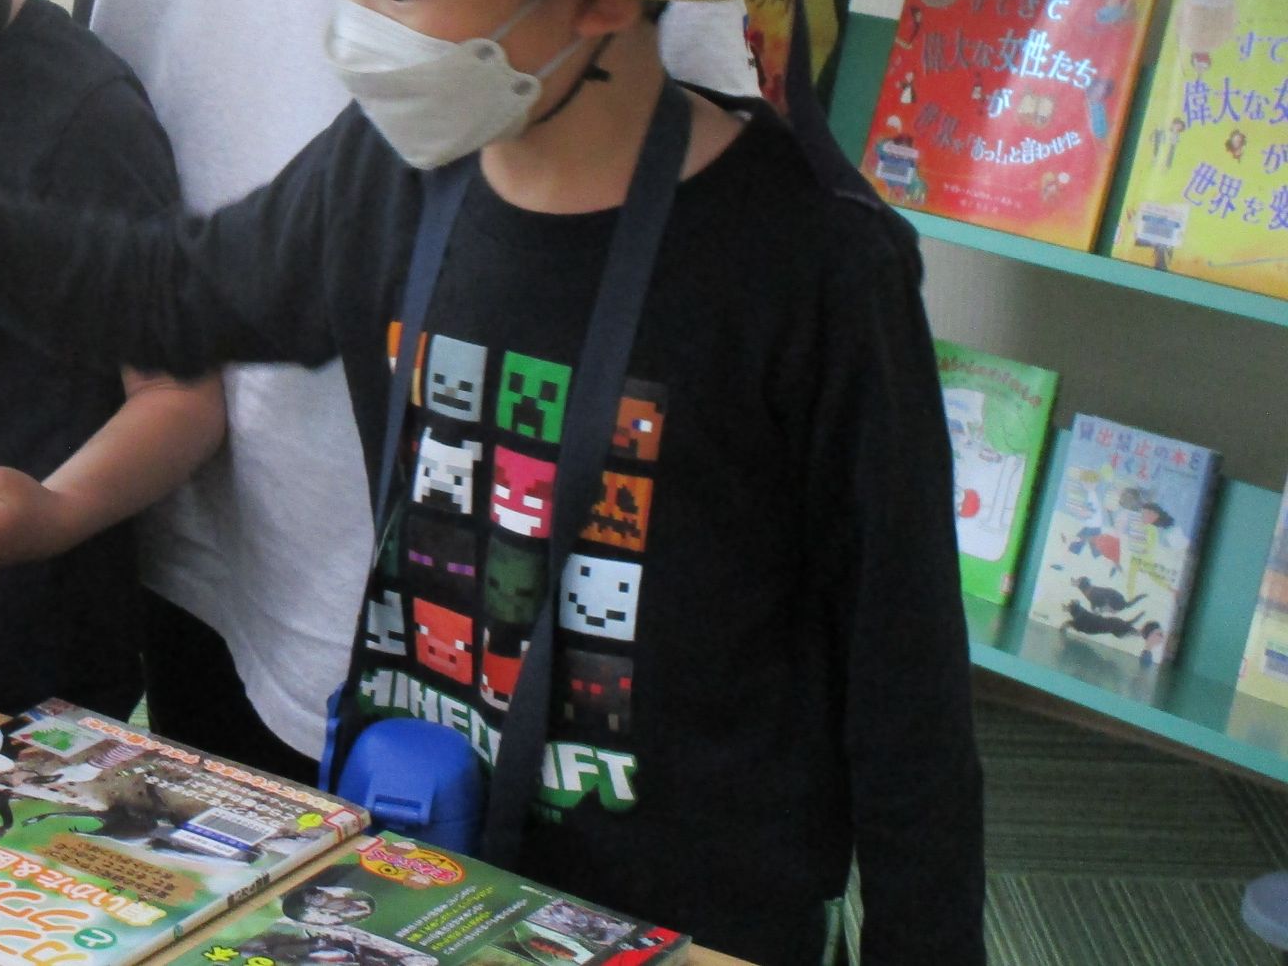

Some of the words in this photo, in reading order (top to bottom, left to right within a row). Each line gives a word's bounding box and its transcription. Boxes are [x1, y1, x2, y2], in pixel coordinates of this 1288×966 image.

[923, 29, 1096, 89] 偉大な女性たち
[988, 88, 1014, 118] が
[360, 669, 635, 802] MINECFT
[78, 927, 116, 950] と
